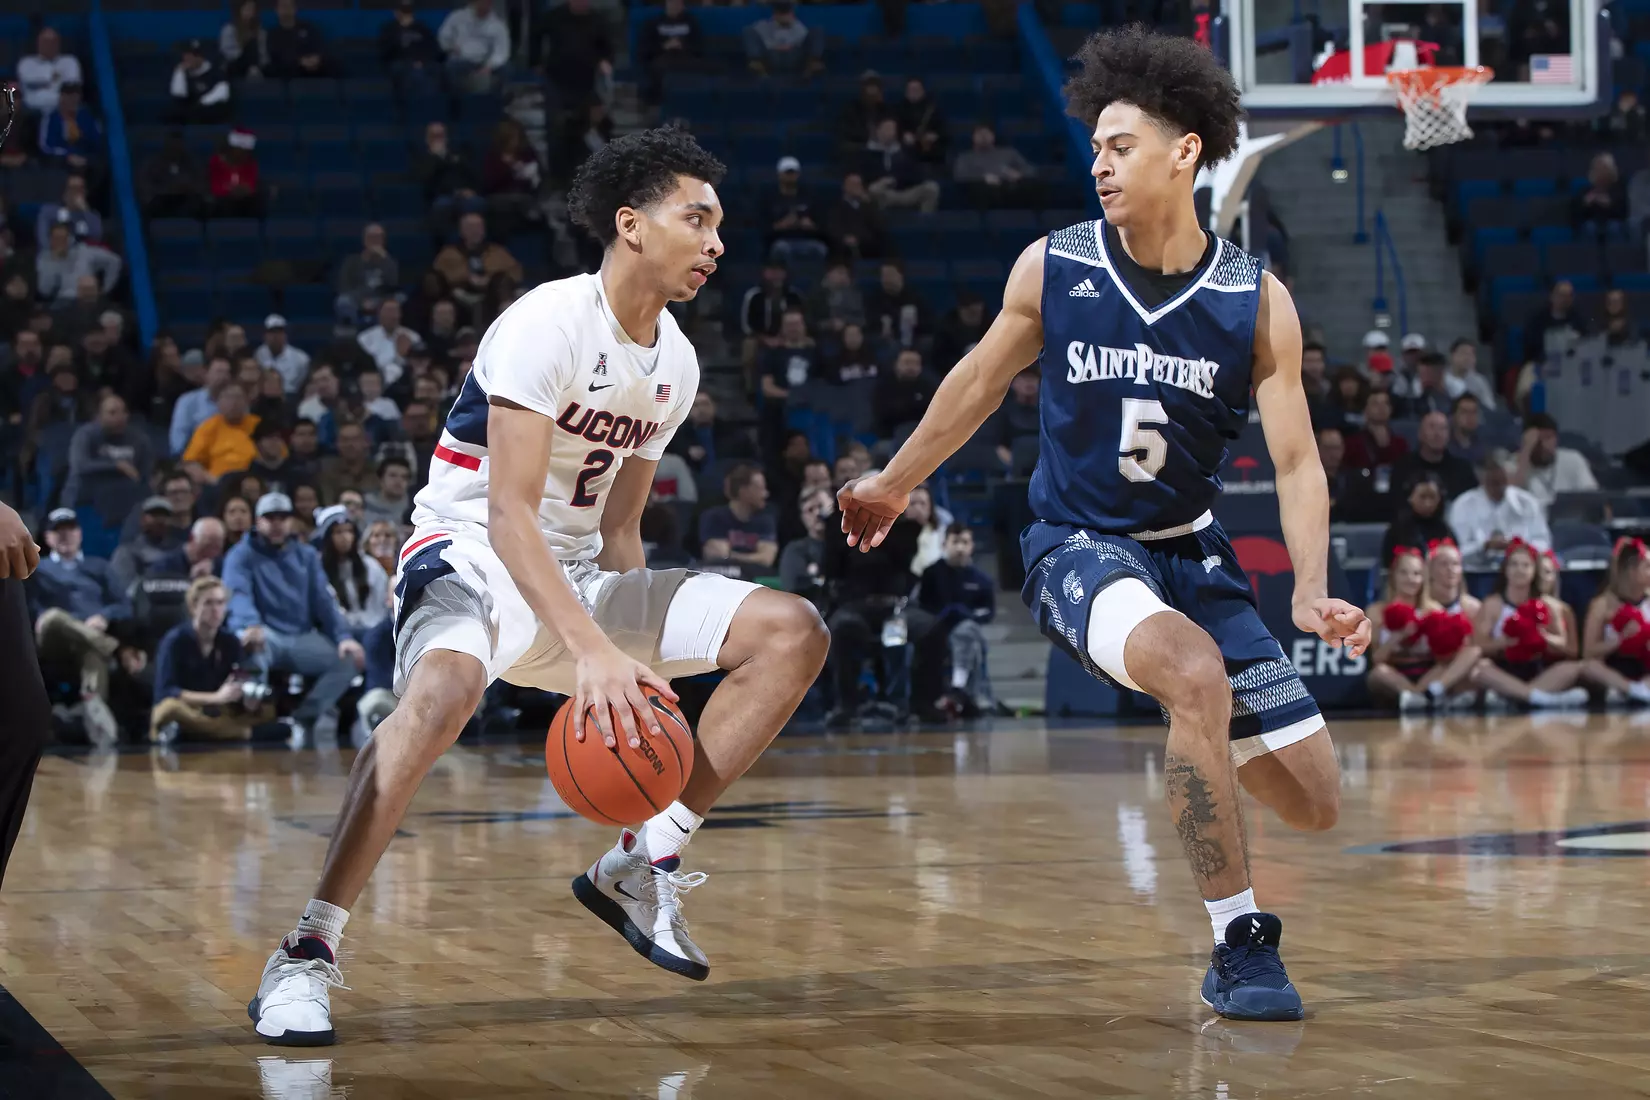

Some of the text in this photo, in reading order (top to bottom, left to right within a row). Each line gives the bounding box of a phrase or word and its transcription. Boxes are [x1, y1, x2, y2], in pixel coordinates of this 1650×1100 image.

[1068, 289, 1100, 298] adidas
[1118, 397, 1169, 483] 5
[569, 448, 615, 508] 2
